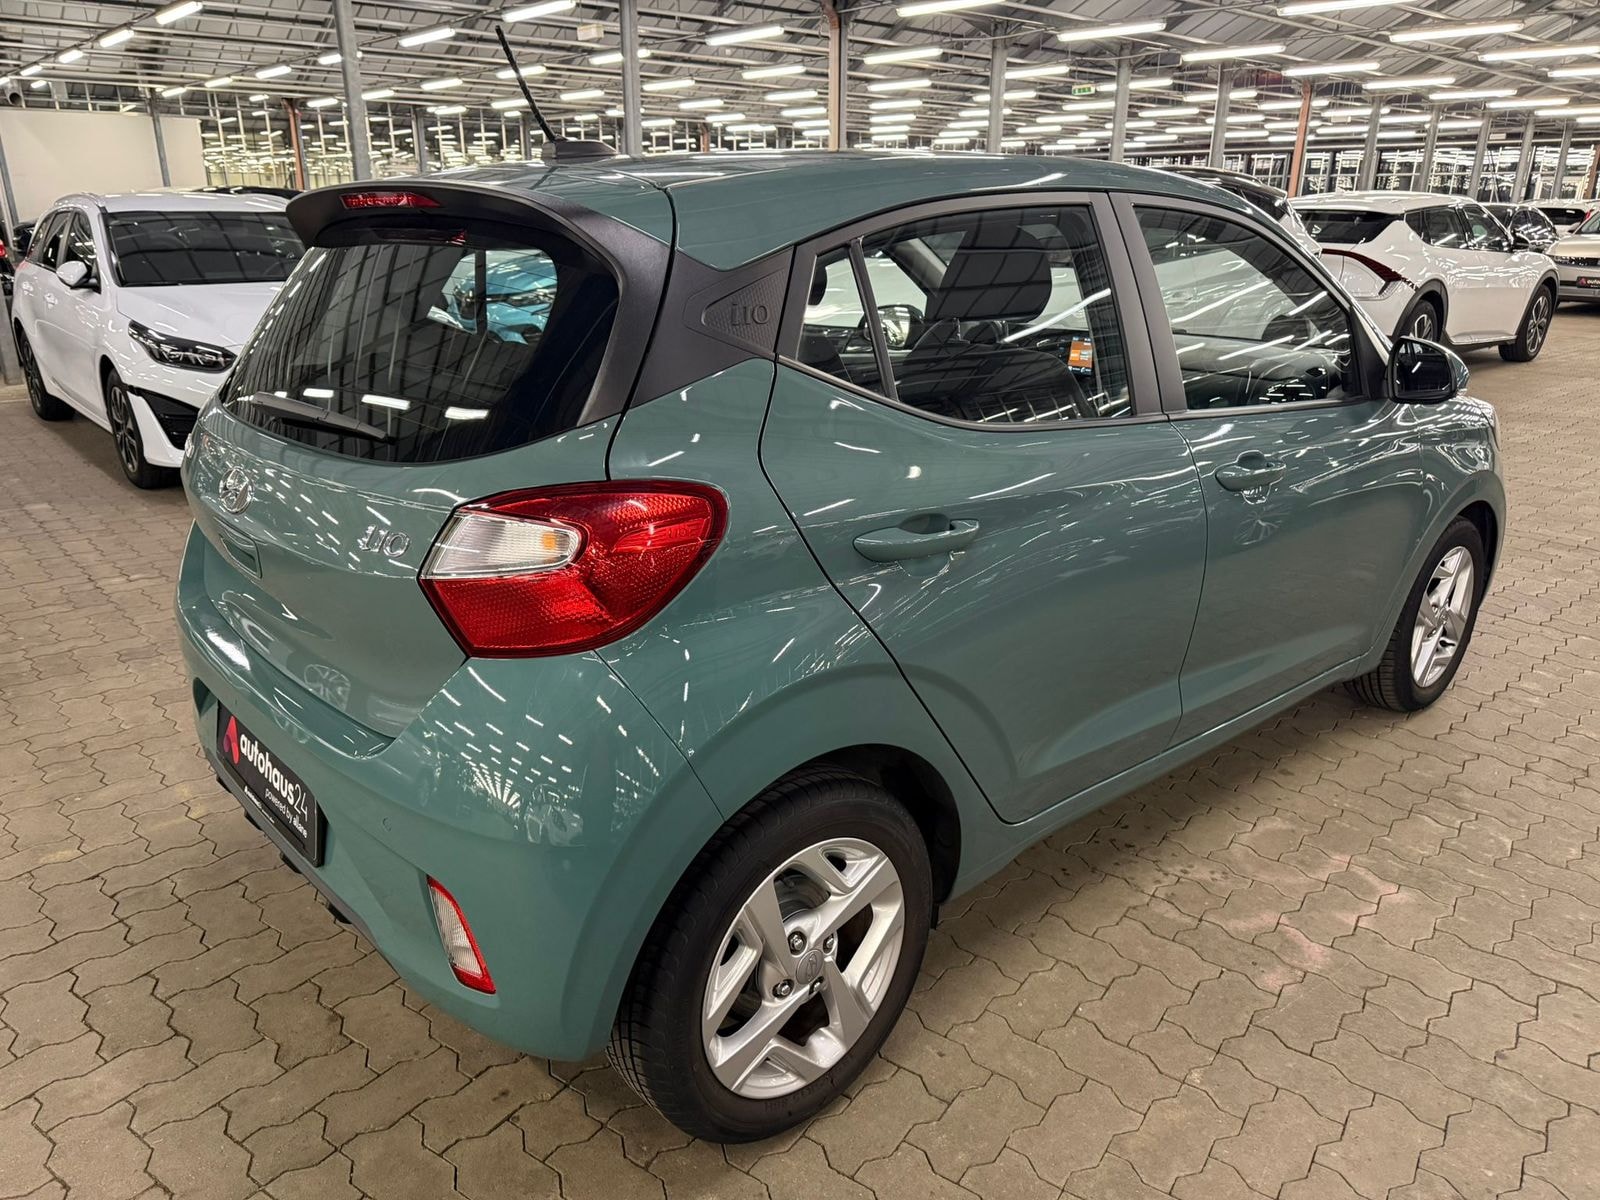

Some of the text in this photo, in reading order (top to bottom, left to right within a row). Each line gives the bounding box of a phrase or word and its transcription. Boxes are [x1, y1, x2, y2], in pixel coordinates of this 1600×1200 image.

[730, 303, 769, 326] i10
[357, 524, 410, 558] i10
[240, 734, 307, 822] autohaus24
[285, 807, 293, 824] by
